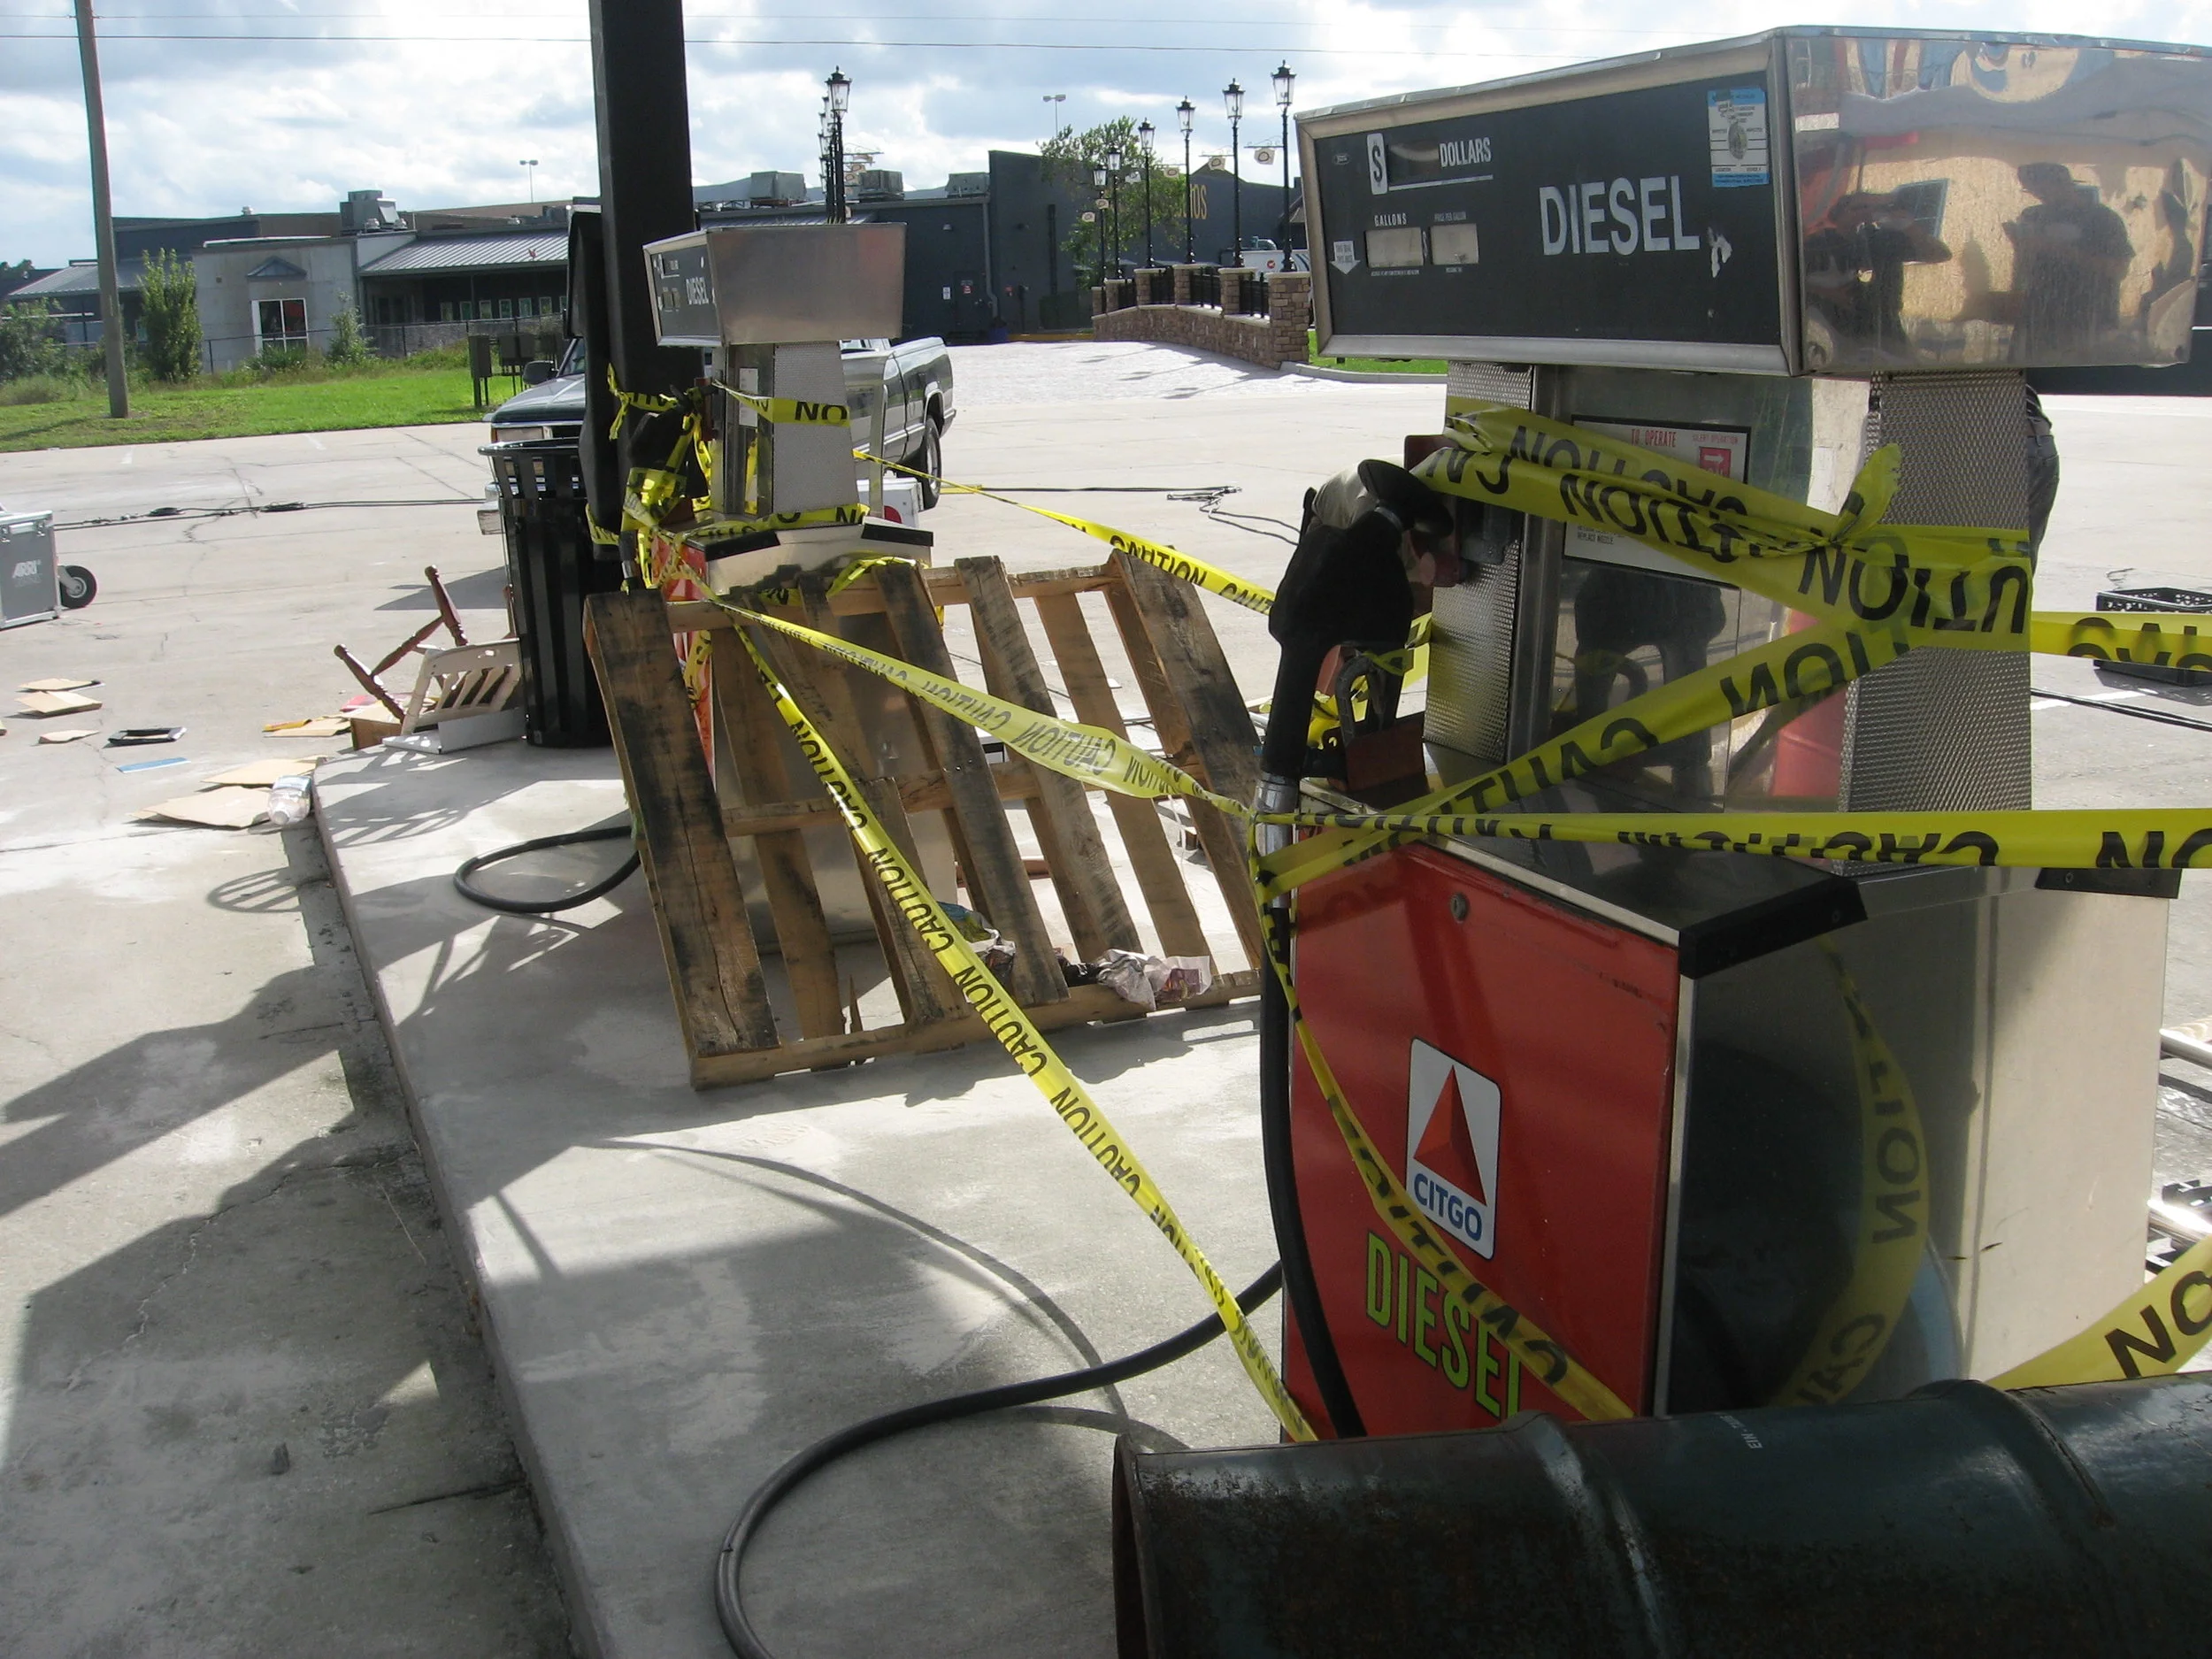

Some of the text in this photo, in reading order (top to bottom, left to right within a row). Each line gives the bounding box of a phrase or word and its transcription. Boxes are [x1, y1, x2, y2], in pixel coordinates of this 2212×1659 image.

[1440, 137, 1492, 168] DOLLARS
[1374, 213, 1407, 227] GALLONS
[1539, 176, 1701, 257] DIESEL
[686, 277, 710, 305] DIESEL
[1631, 428, 1640, 446] TO
[1645, 430, 1677, 448] OPERATE
[867, 847, 956, 953] CAUTION
[953, 965, 1048, 1077] CAUTION
[1049, 1087, 1141, 1197] CAUTION
[1414, 1172, 1483, 1242] CITGO
